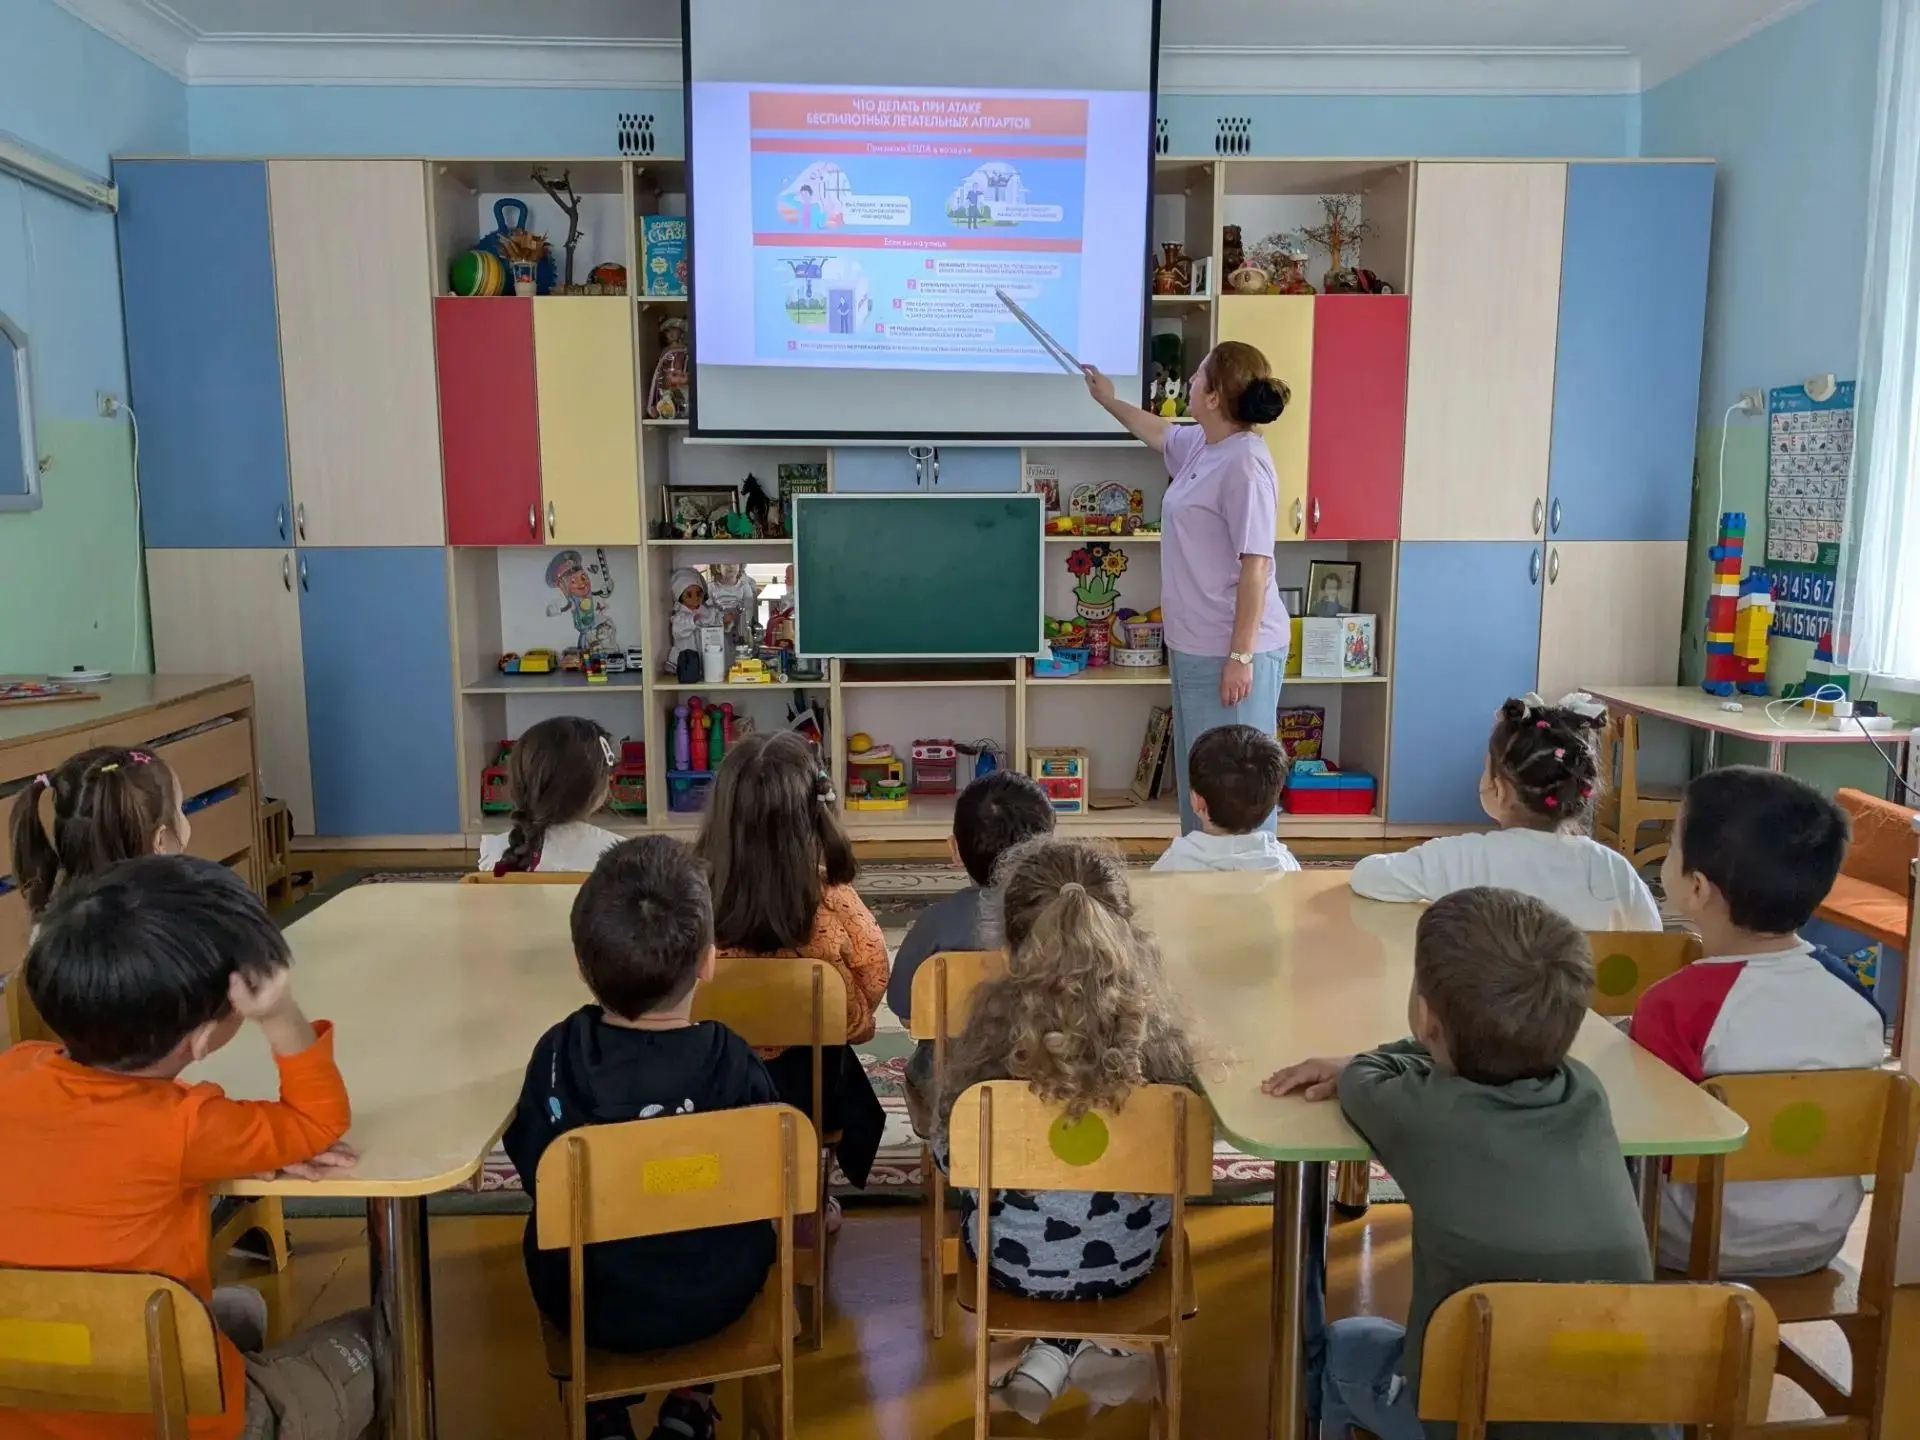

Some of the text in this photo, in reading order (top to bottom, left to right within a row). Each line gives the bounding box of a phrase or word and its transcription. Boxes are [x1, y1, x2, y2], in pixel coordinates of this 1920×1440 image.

[852, 97, 981, 113] ЧТО ДЕЛАТЬ ПРИ АТАКЕ
[806, 112, 890, 126] БЕСПИЛОТНЫХ
[891, 114, 969, 128] ЛЕТАТЕЛЬНЫХ
[792, 485, 817, 493] КНИГА
[1781, 575, 1788, 597] 3
[1791, 576, 1800, 598] 4
[1802, 578, 1810, 599] 5
[1813, 579, 1822, 601] 6
[1825, 580, 1834, 603] 7
[1781, 611, 1792, 632] 14
[1793, 613, 1804, 635] 15
[1805, 614, 1816, 637] 16
[1817, 616, 1830, 638] 17
